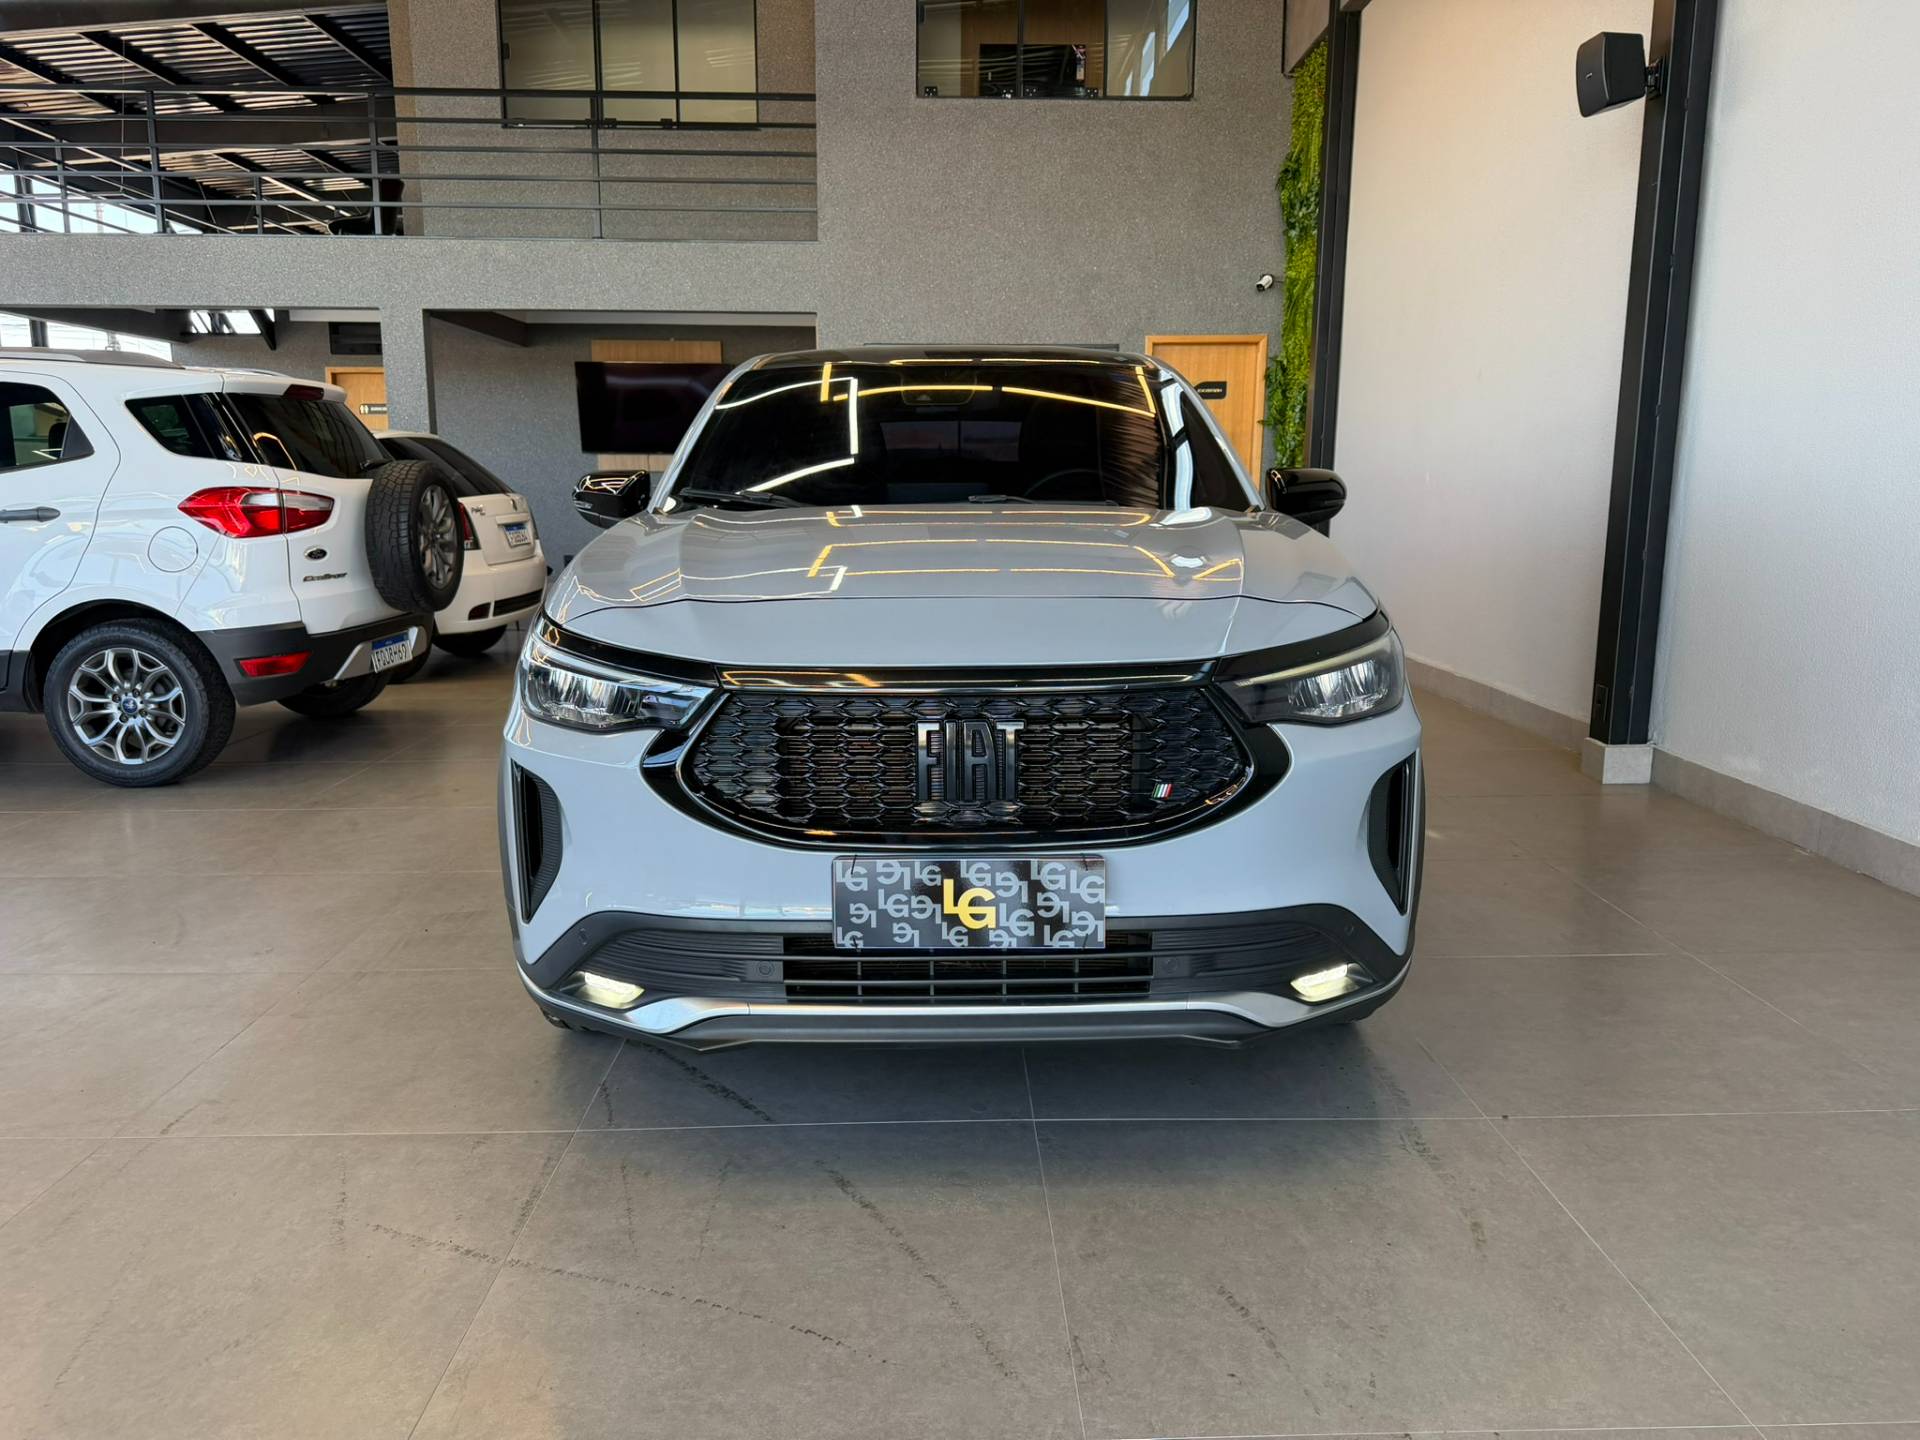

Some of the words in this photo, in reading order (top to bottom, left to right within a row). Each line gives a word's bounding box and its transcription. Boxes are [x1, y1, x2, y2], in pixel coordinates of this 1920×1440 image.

[916, 720, 1025, 801] FIAT
[836, 860, 868, 891] LG
[914, 860, 941, 886] LG
[960, 860, 991, 886] LG
[1031, 860, 1066, 890] LG
[1070, 870, 1104, 903] LG
[878, 889, 910, 918] LG
[943, 879, 996, 929] LG
[942, 922, 969, 947] LG
[999, 903, 1035, 937] LG
[837, 927, 864, 948] LG
[1044, 925, 1075, 948] LG
